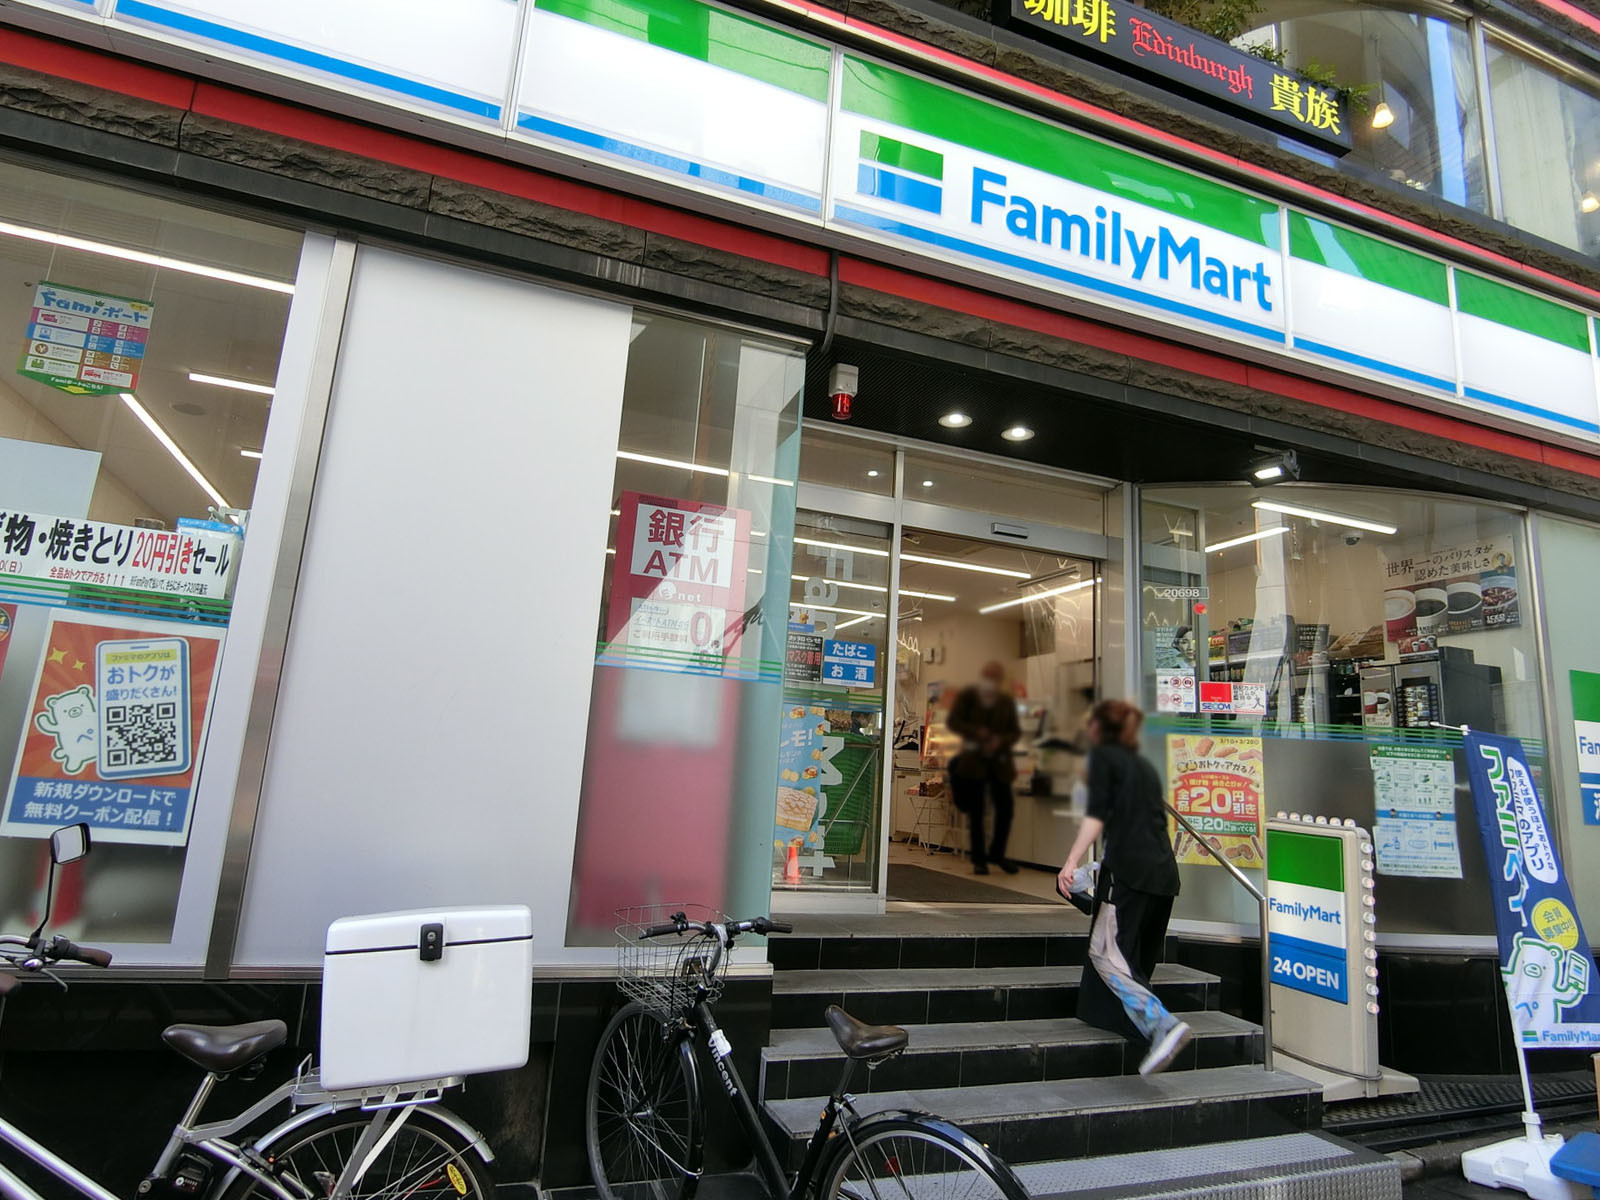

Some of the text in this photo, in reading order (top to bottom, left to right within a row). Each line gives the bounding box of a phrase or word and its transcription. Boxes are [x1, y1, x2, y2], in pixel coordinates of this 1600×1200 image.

[1128, 16, 1254, 99] Edinburgh
[1269, 73, 1341, 135] 貴族
[970, 166, 1273, 311] FamilyMart
[648, 509, 725, 553] 銀行
[0, 512, 229, 577] 物・焼きとり20円引きセール
[643, 550, 718, 584] ATM
[1415, 559, 1491, 582] 認めた美味しさ
[1164, 588, 1200, 598] 20698
[832, 642, 868, 658] たばこ
[107, 665, 175, 685] おトクが
[1202, 702, 1231, 710] SECOM
[33, 781, 176, 806] 新規ダウンロードで
[1269, 897, 1340, 924] FamilyMart
